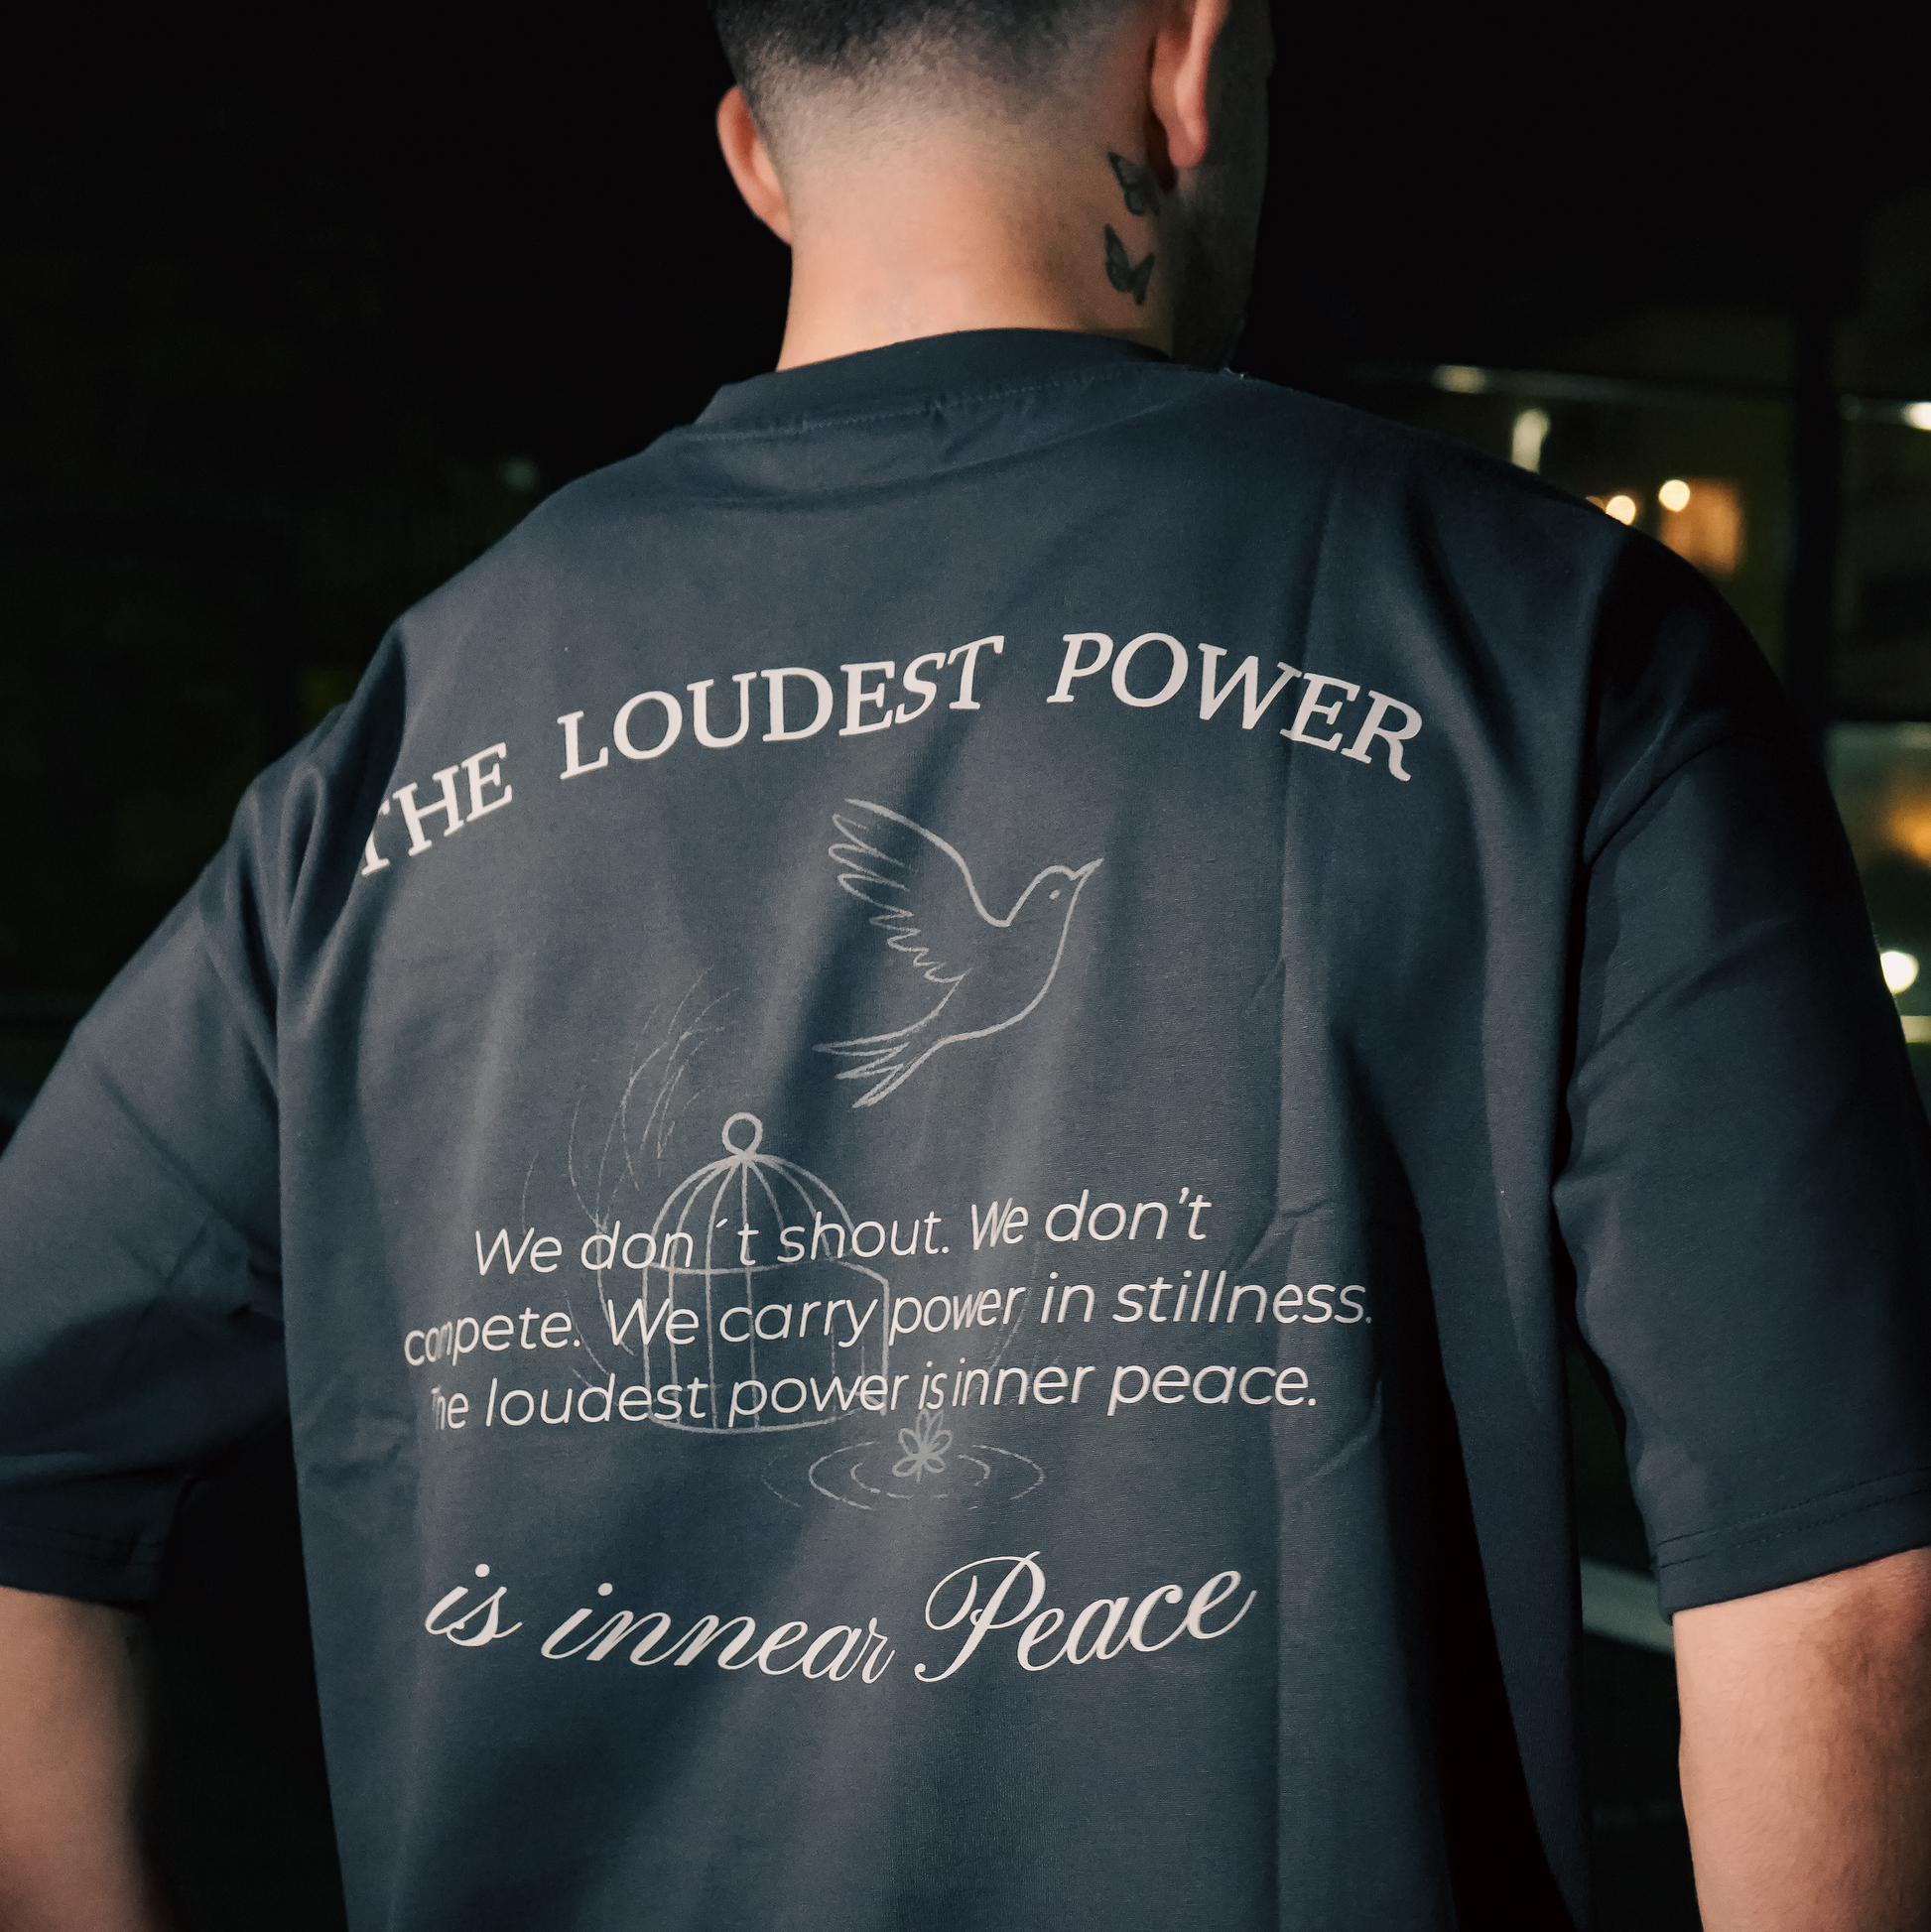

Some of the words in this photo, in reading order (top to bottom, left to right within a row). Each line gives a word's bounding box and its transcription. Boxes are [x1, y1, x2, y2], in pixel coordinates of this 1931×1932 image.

[361, 741, 513, 876] THE
[557, 635, 1005, 780] LOUDEST
[1046, 632, 1422, 782] POWER
[475, 1226, 563, 1276] We
[777, 1211, 950, 1263] shout.
[970, 1197, 1029, 1251] We
[607, 1297, 700, 1346] We
[719, 1298, 879, 1348] carry
[888, 1286, 1027, 1347] power
[1040, 1271, 1094, 1324] in
[1112, 1269, 1374, 1324] stillness.
[485, 1372, 708, 1427] loudest
[728, 1374, 910, 1428] power
[918, 1360, 948, 1410] is
[952, 1356, 1095, 1407] inner
[1106, 1364, 1317, 1417] peace.
[425, 1563, 523, 1647] is
[541, 1583, 896, 1684] innear
[914, 1551, 1256, 1683] Peace
